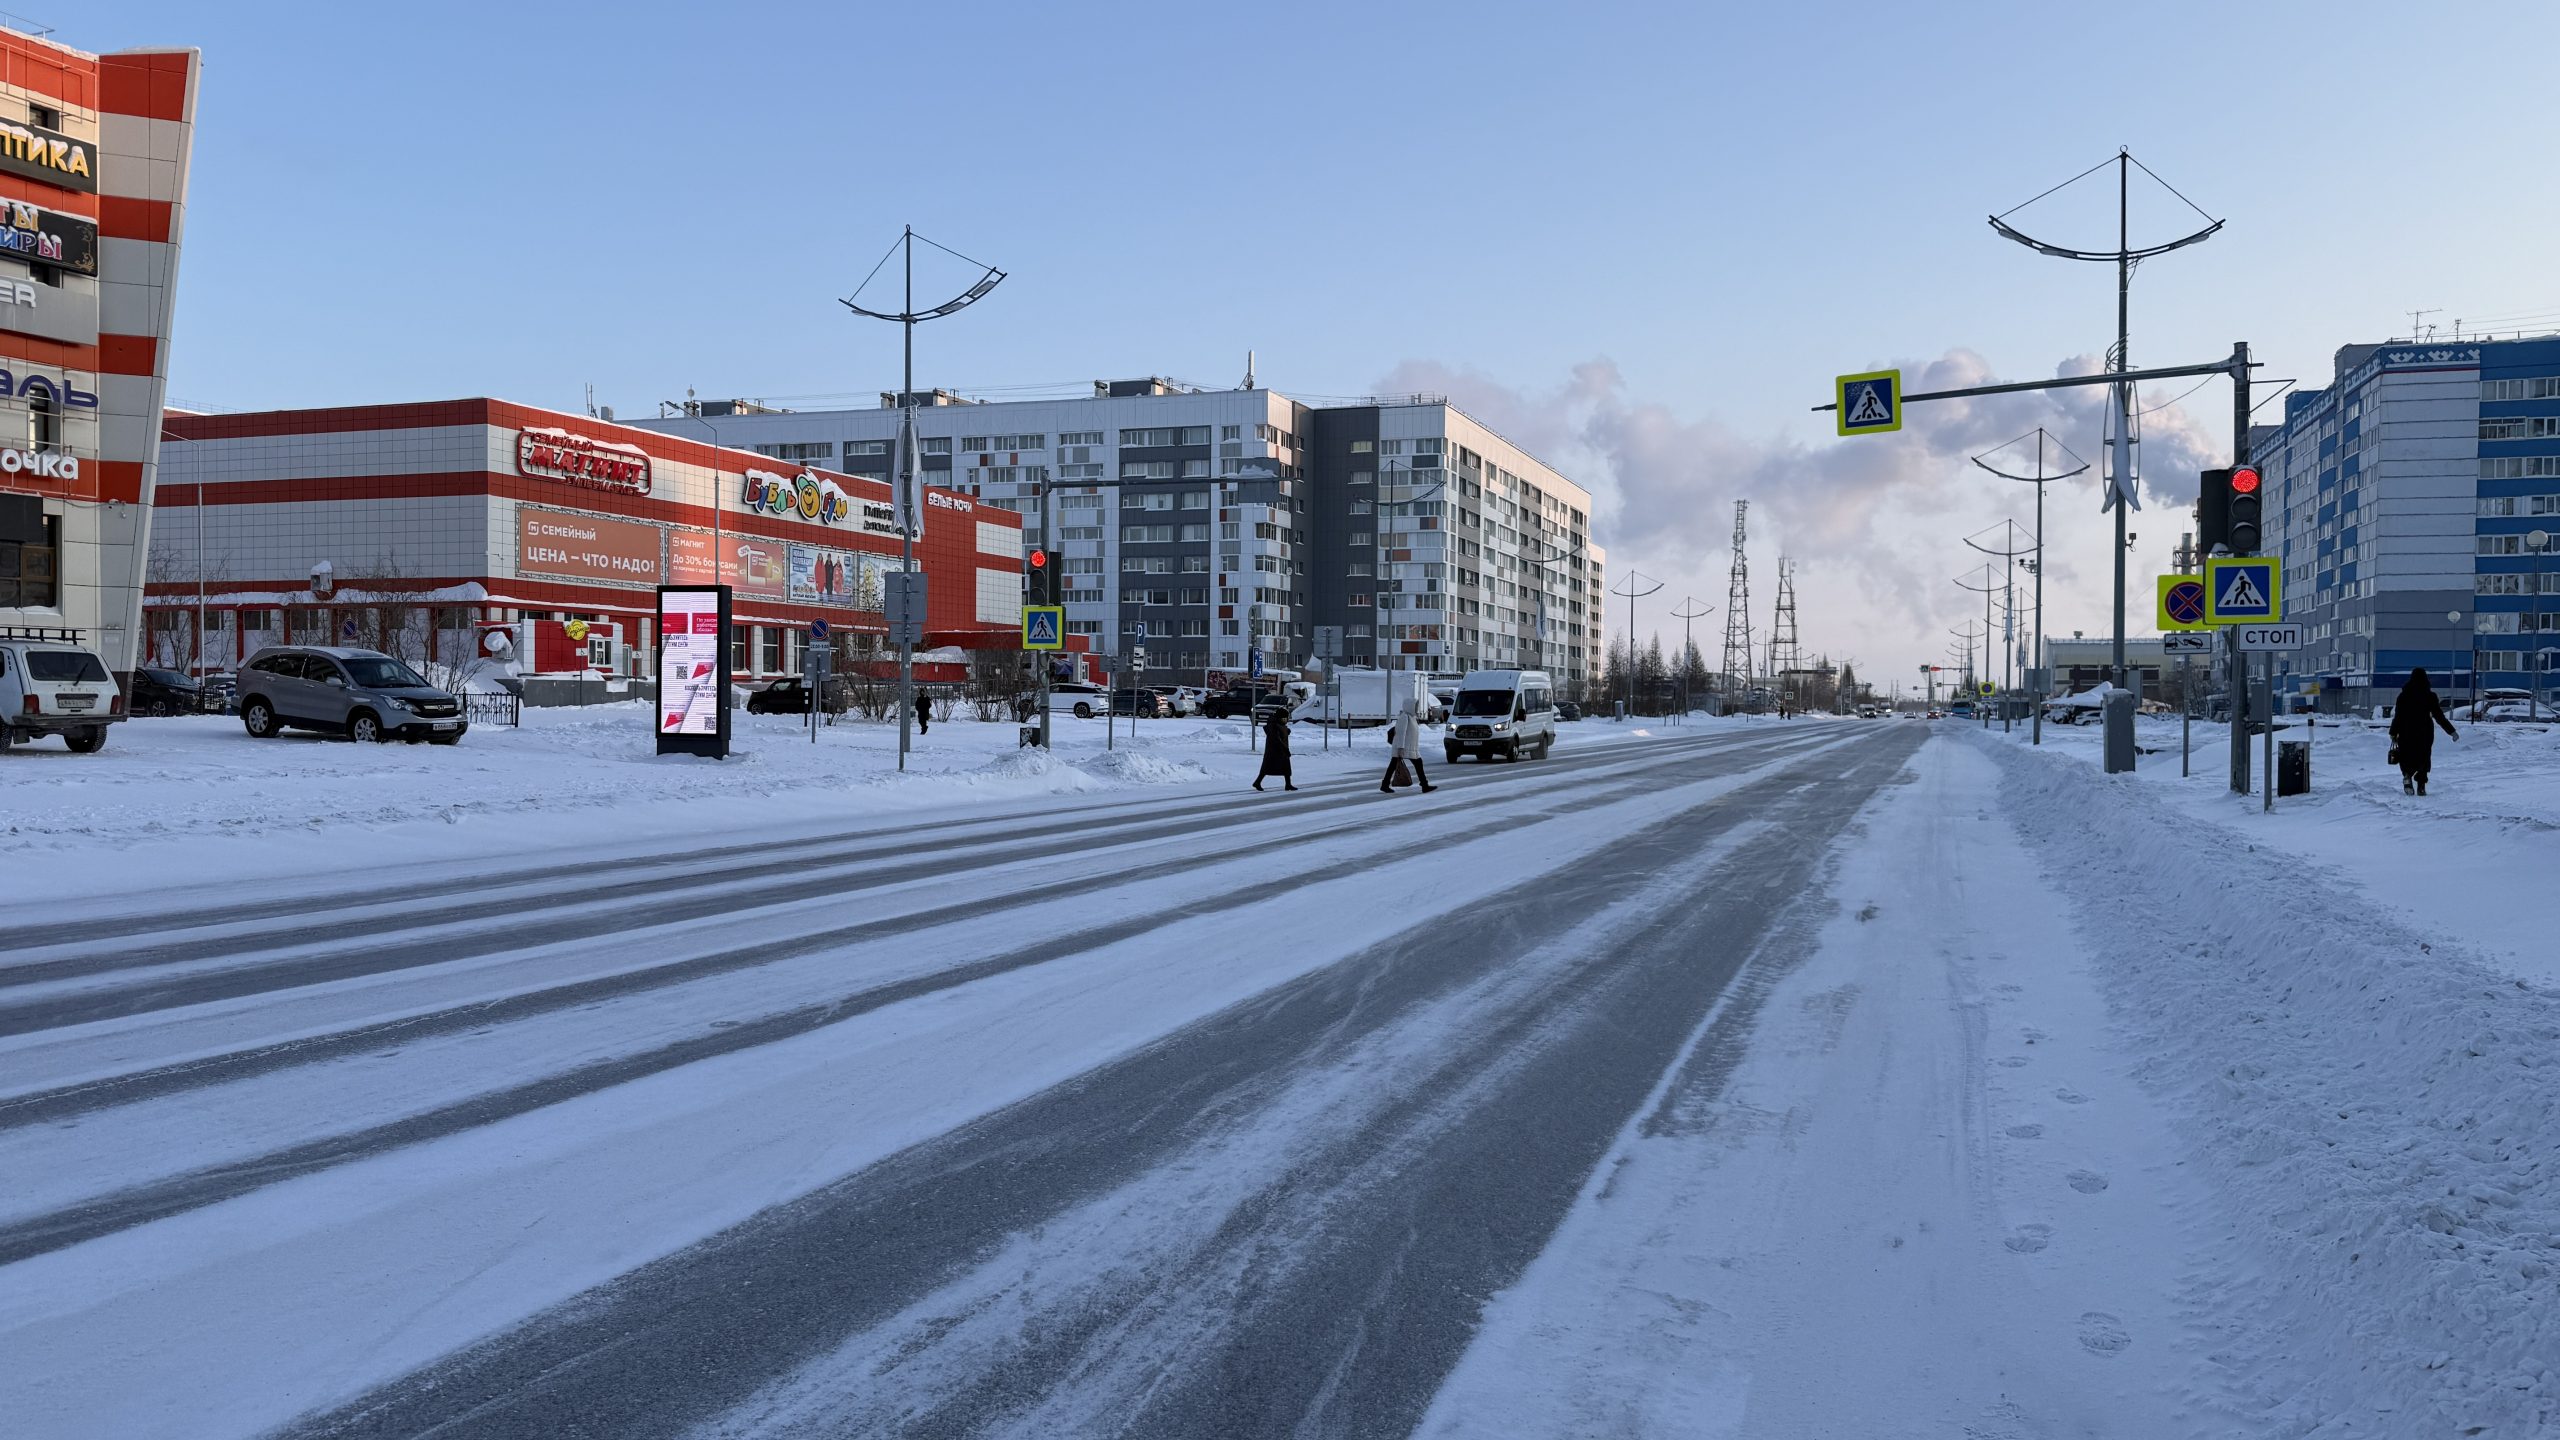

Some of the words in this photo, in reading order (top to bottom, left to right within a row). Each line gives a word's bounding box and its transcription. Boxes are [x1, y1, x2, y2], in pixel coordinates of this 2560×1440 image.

[1, 449, 79, 480] очка
[529, 444, 644, 484] МАГНИТ
[541, 524, 596, 541] СЕМЕЙНЫЙ
[680, 538, 705, 549] МАГНИТ
[527, 546, 568, 564] ЦЕНА
[582, 552, 609, 568] ЧТО
[612, 555, 655, 573] НАДО!
[672, 553, 684, 564] До
[685, 554, 702, 567] 30%
[2245, 630, 2295, 644] СТОП
